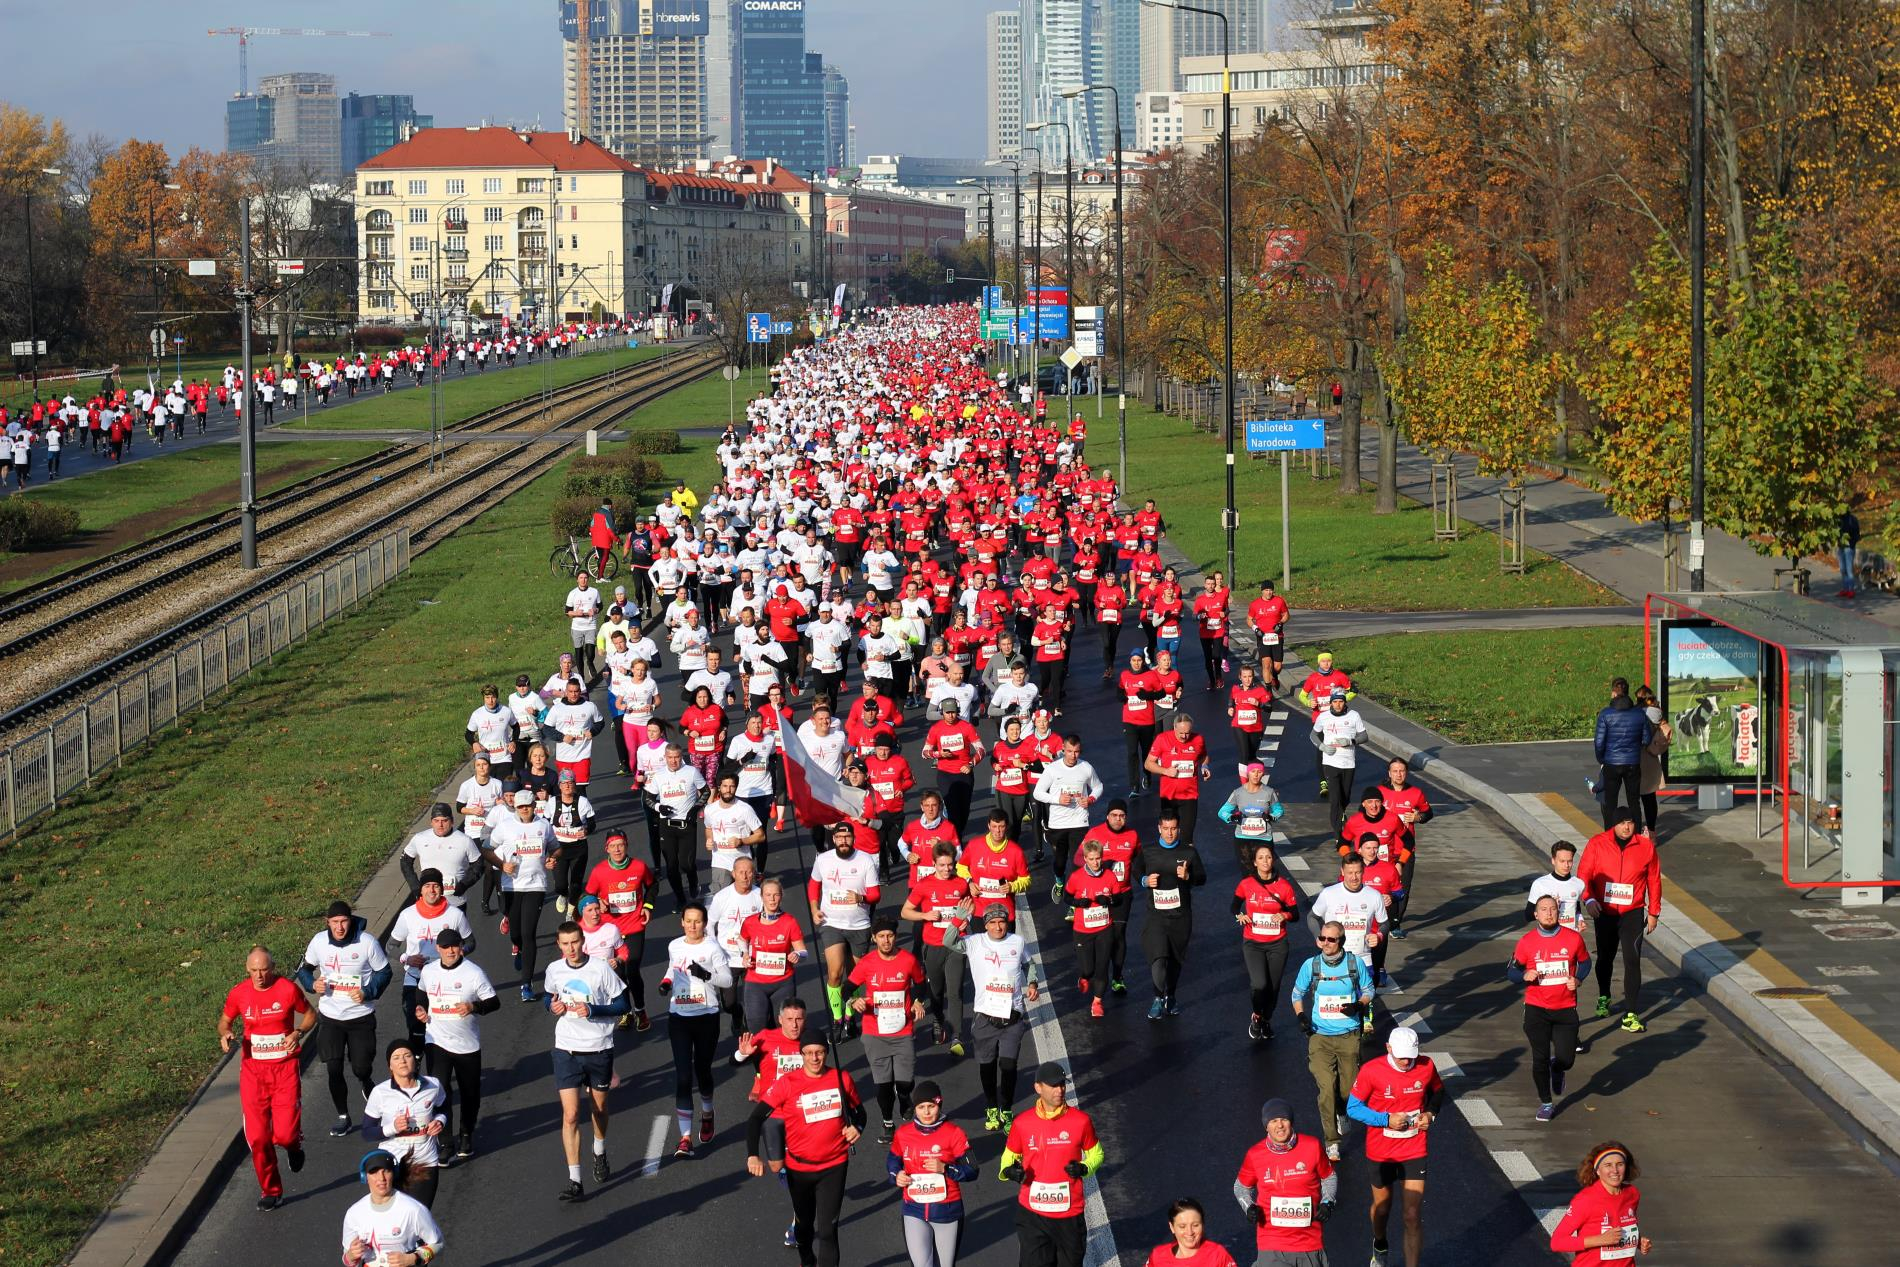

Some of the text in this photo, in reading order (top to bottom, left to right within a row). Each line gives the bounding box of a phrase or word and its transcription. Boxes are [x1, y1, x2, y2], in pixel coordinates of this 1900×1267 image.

[744, 1, 802, 11] COMARCH
[1250, 422, 1294, 433] Biblioteka
[1251, 436, 1297, 448] Narodowa
[1696, 651, 1721, 659] czeka
[1732, 650, 1757, 659] domu
[1738, 711, 1750, 760] łaciate
[1324, 1003, 1341, 1013] 461
[782, 1063, 804, 1073] 648
[812, 1099, 833, 1113] 787
[916, 1183, 937, 1194] 365
[1034, 1192, 1065, 1203] 4950
[1275, 1205, 1309, 1218] 15968
